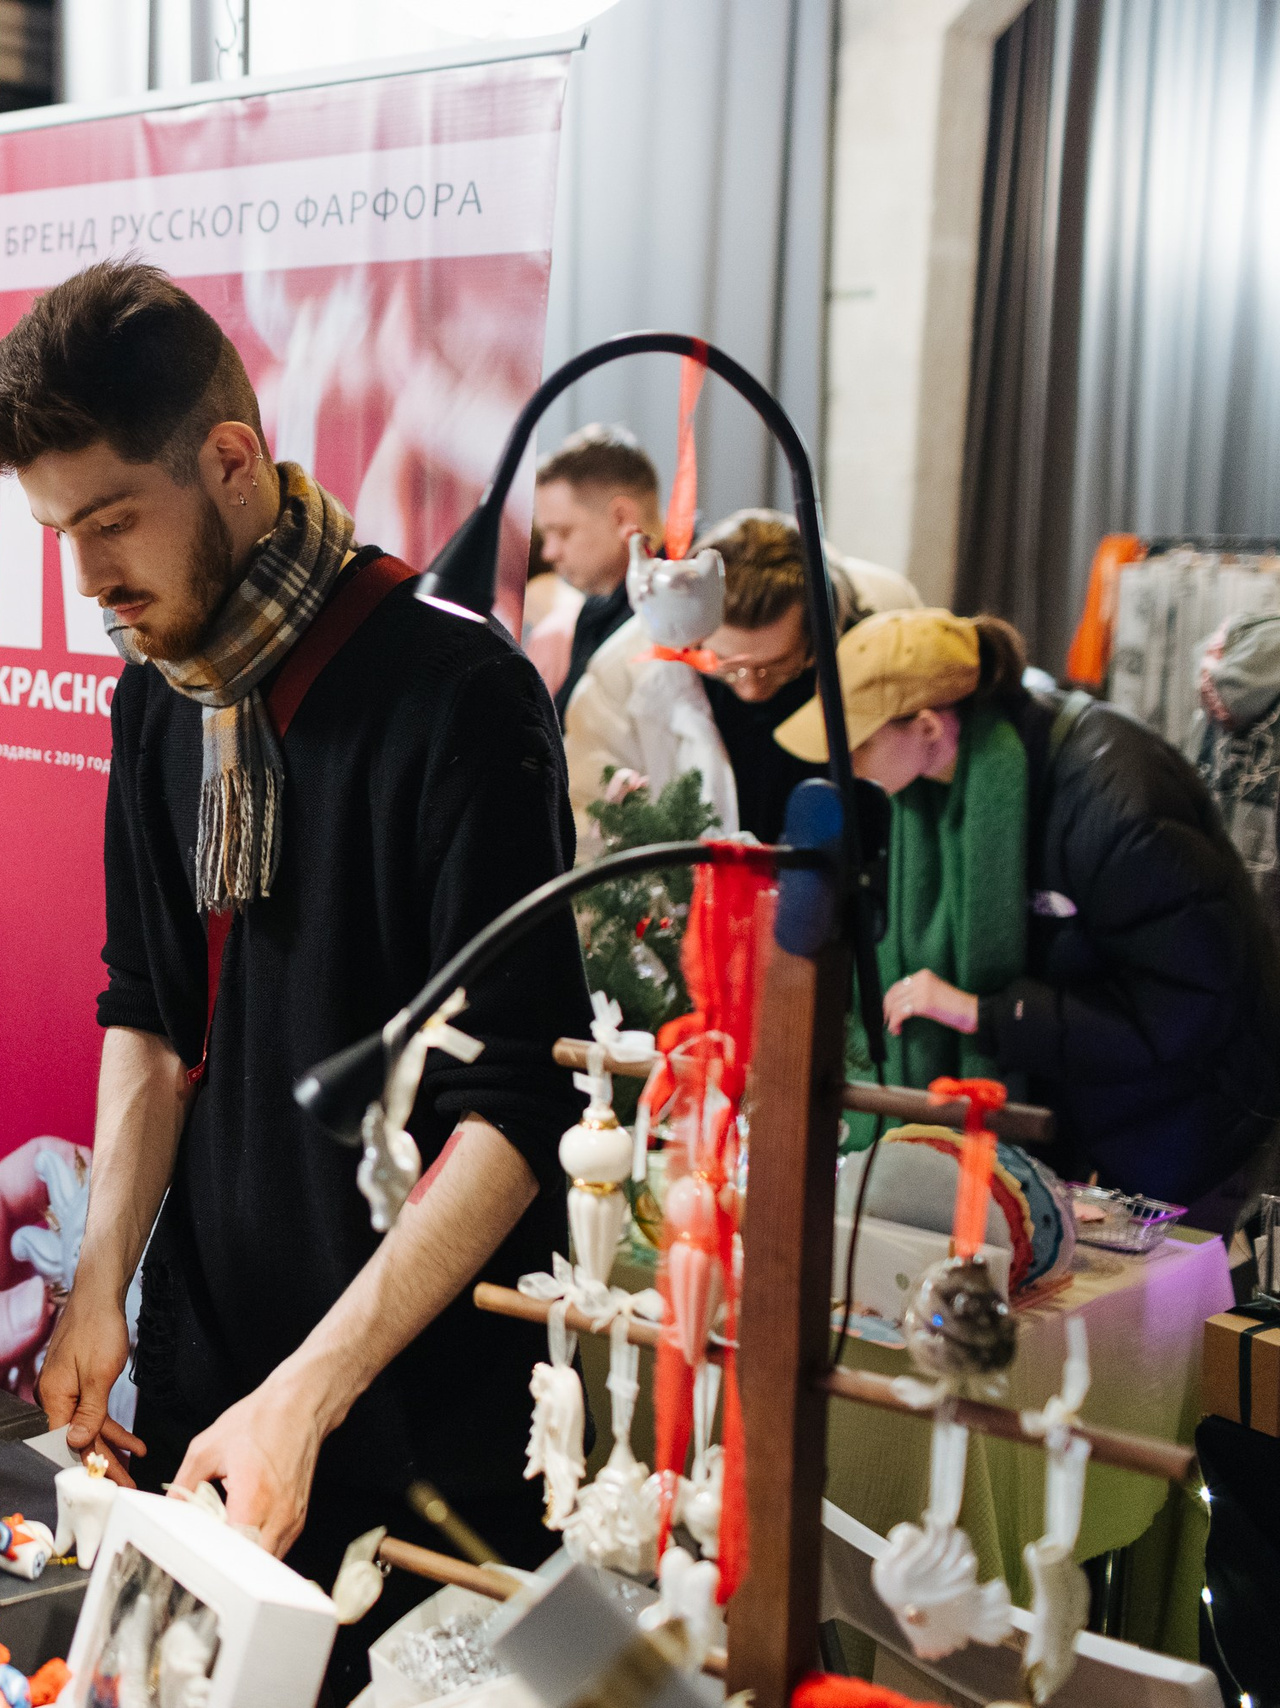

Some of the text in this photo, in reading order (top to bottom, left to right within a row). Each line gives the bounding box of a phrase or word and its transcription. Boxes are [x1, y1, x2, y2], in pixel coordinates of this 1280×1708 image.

[5, 180, 482, 257] БРЕНД РУССКОГО ФАРФОРА
[54, 750, 85, 771] 2019
[86, 756, 111, 774] год
